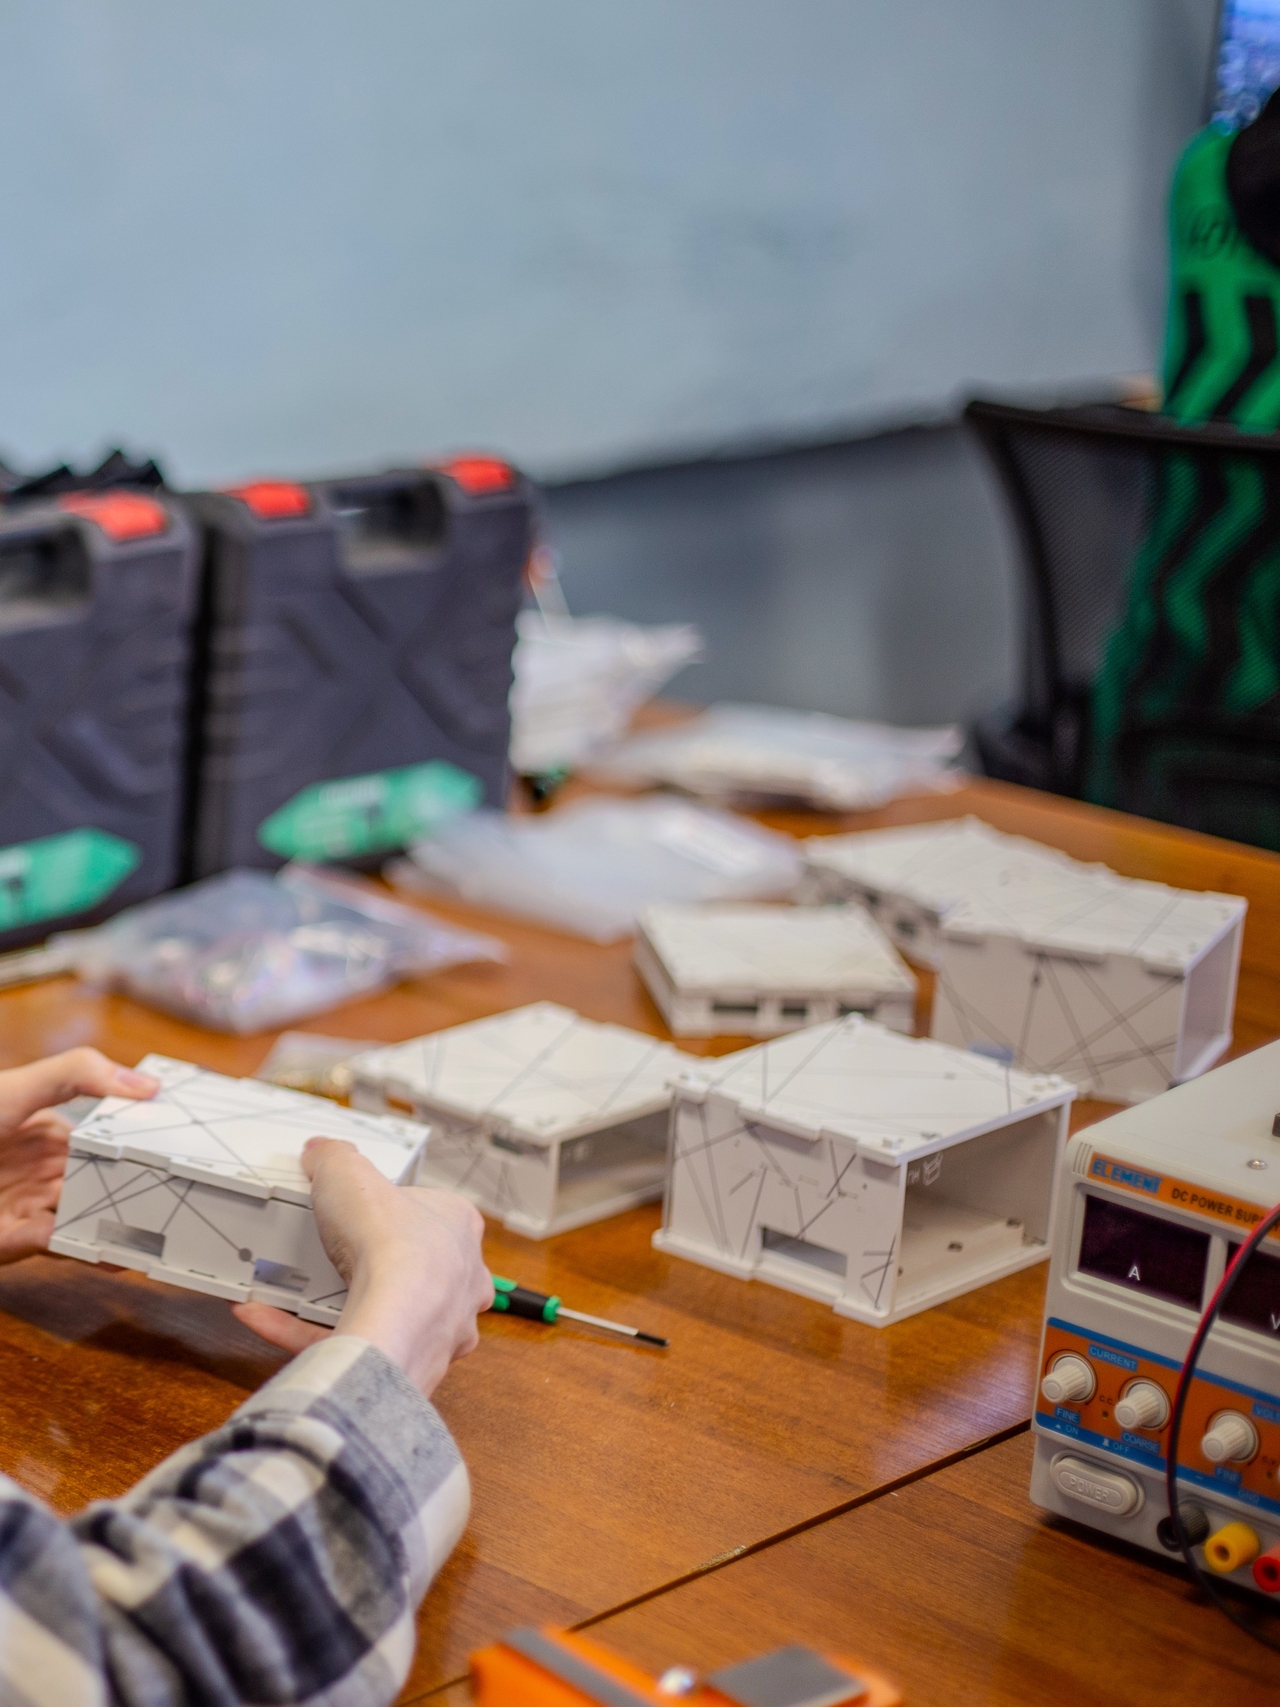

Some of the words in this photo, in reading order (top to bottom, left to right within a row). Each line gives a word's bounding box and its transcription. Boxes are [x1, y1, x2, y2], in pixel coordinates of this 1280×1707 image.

[1092, 1158, 1162, 1194] ELEMENT
[1172, 1188, 1187, 1202] DC
[1190, 1194, 1233, 1216] POWER
[1128, 1265, 1140, 1281] A
[1089, 1346, 1136, 1370] CURRENT
[1056, 1408, 1078, 1423] FINE
[1065, 1424, 1079, 1436] ON
[1112, 1442, 1130, 1453] OFF
[1123, 1432, 1159, 1451] COARSE
[1071, 1475, 1109, 1499] POWER
